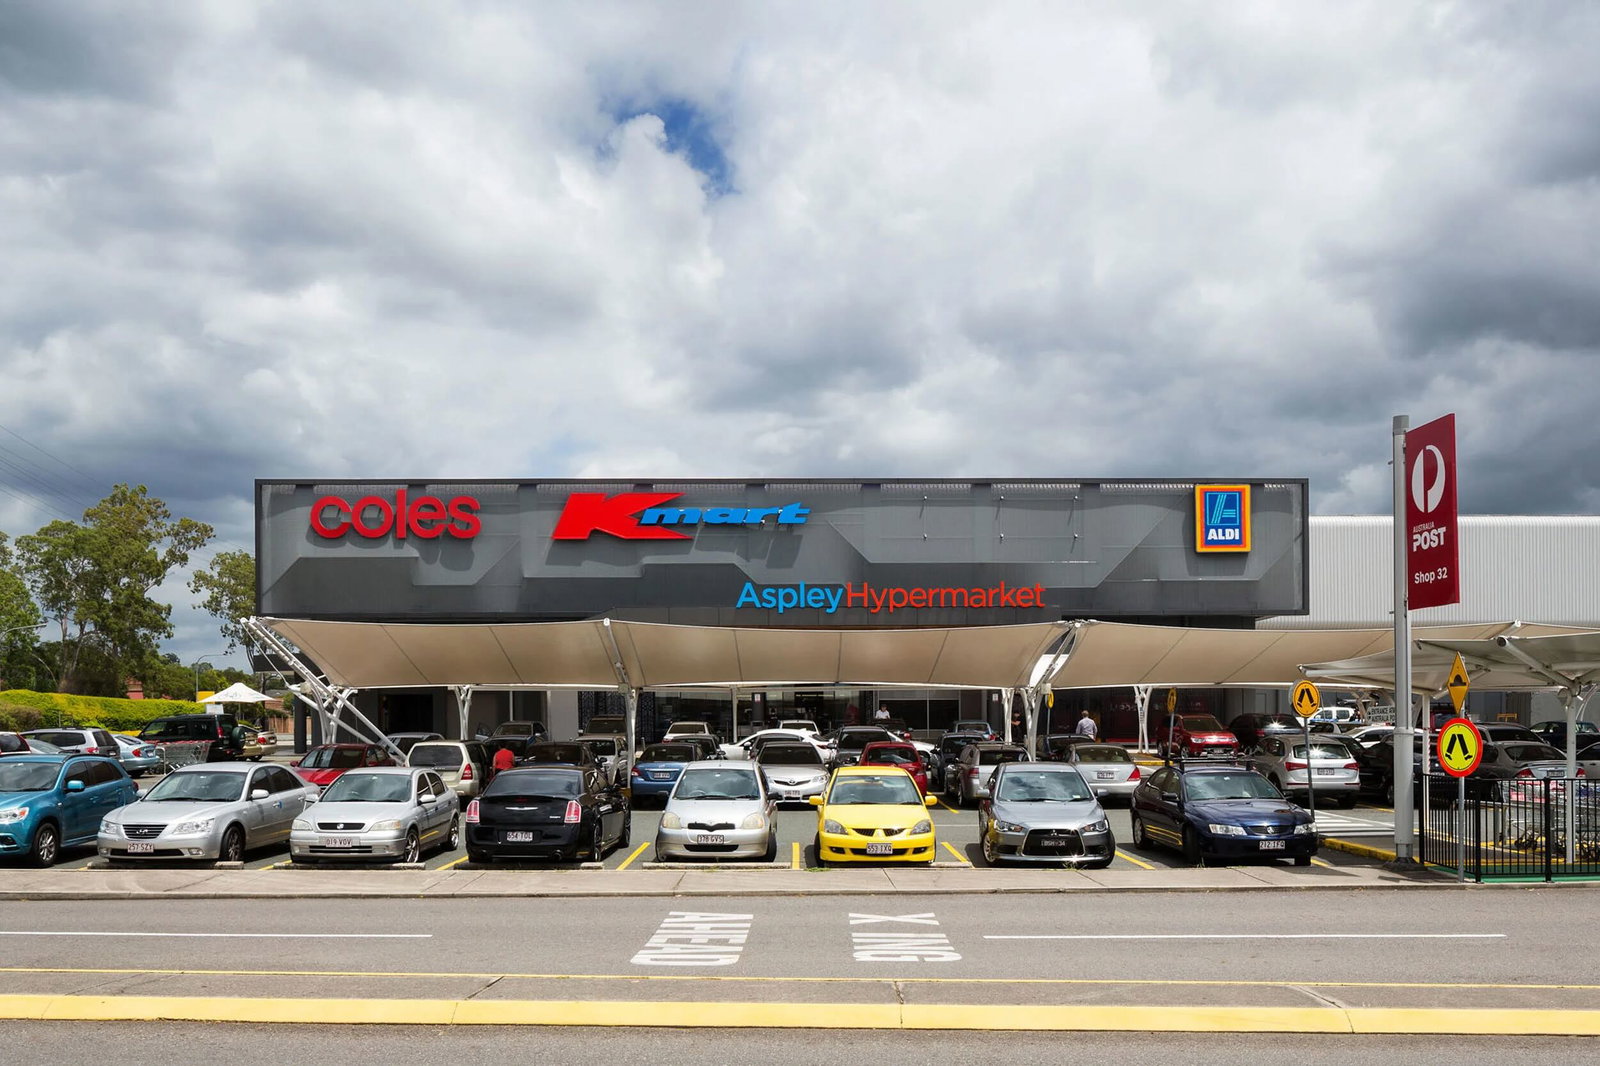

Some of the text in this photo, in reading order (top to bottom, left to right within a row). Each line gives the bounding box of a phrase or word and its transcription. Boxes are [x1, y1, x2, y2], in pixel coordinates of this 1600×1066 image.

[310, 488, 482, 539] coles
[1207, 528, 1240, 540] ALDI
[1412, 521, 1435, 533] AUSTRALIA
[1412, 526, 1447, 552] POST
[1414, 567, 1448, 584] Shop 32
[735, 580, 1046, 613] Aspley Hypermarket
[630, 911, 754, 966] AHEAD
